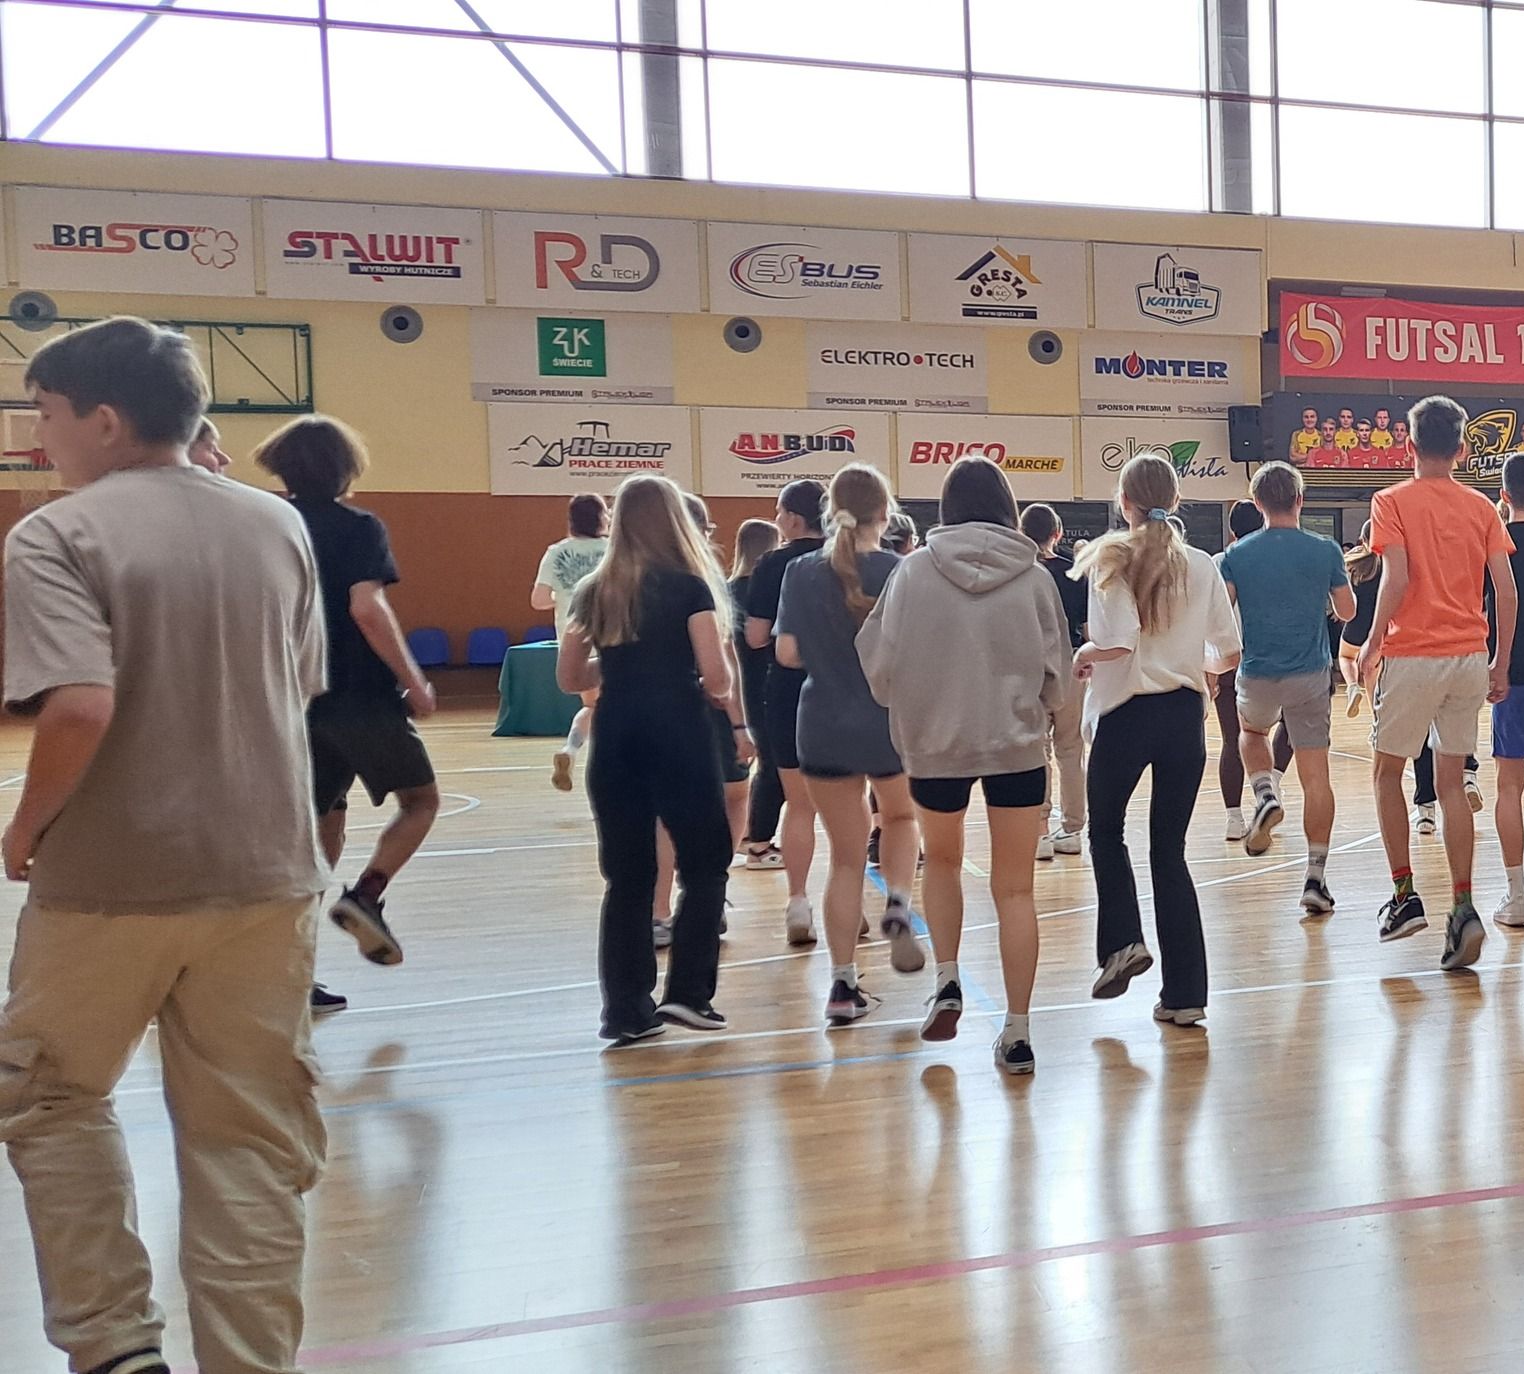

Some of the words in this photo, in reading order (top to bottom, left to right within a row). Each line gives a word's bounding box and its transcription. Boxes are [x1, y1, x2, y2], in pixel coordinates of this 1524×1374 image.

[52, 223, 191, 253] BASCO
[283, 231, 460, 264] STALWIT
[358, 264, 402, 275] WYROBY
[404, 266, 453, 276] HUTNICZE
[612, 269, 641, 279] TECH
[801, 279, 848, 289] Sebastian
[850, 281, 884, 290] Eichler
[970, 269, 1027, 299] GRESTA
[1145, 297, 1213, 309] KAMNEL
[1366, 316, 1504, 364] FUTSAL
[552, 358, 593, 368] ŚWIECIE
[1095, 355, 1228, 378] MONTER
[491, 388, 537, 398] SPONSOR
[539, 389, 583, 398] PREMIUM
[825, 397, 866, 406] SPONSOR
[868, 399, 907, 407] PREMIUM
[1096, 404, 1134, 412] SPONSOR
[569, 437, 672, 457] Hemar
[569, 459, 613, 469] PRACE
[615, 459, 665, 469] ZIEMNE
[741, 472, 791, 480] PRZEWIERTY
